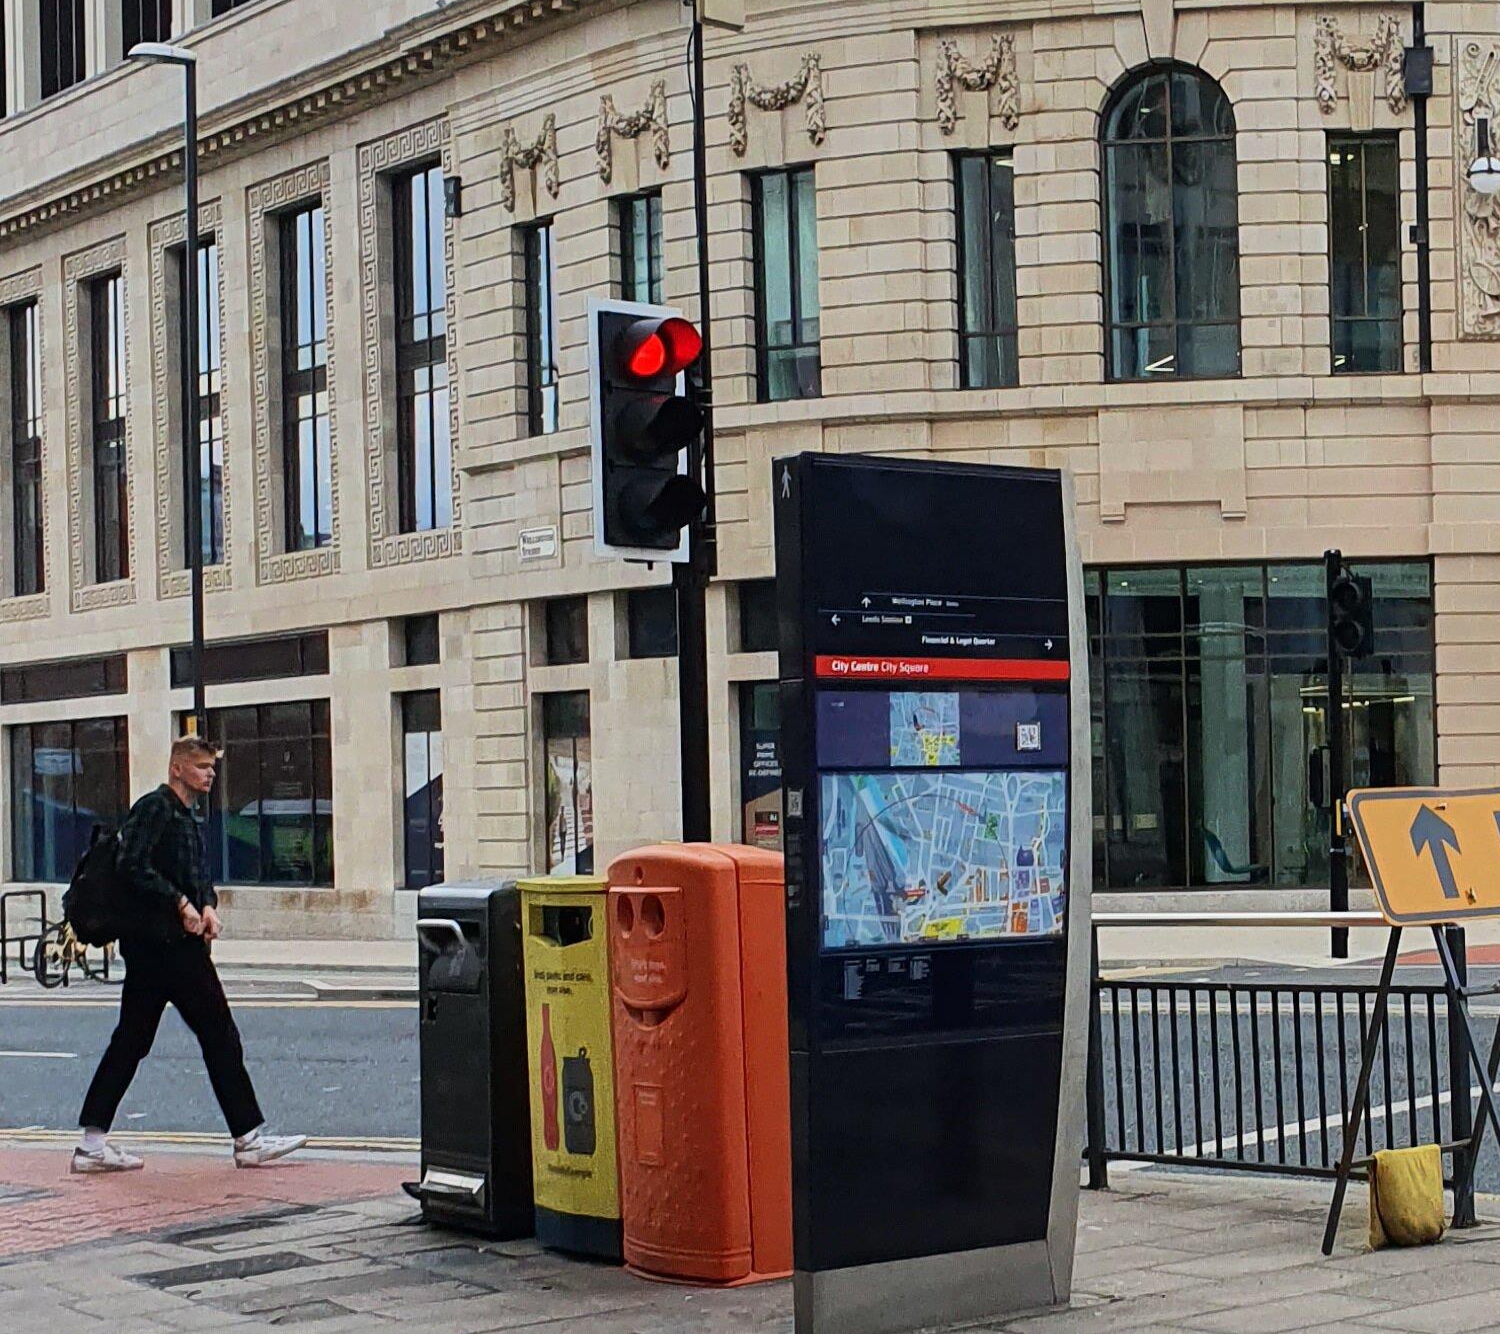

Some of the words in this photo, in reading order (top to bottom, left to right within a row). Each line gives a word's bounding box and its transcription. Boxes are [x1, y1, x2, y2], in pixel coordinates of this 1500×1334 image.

[831, 660, 850, 674] City
[850, 660, 880, 672] Centre
[881, 661, 898, 675] City
[899, 662, 930, 675] Square
